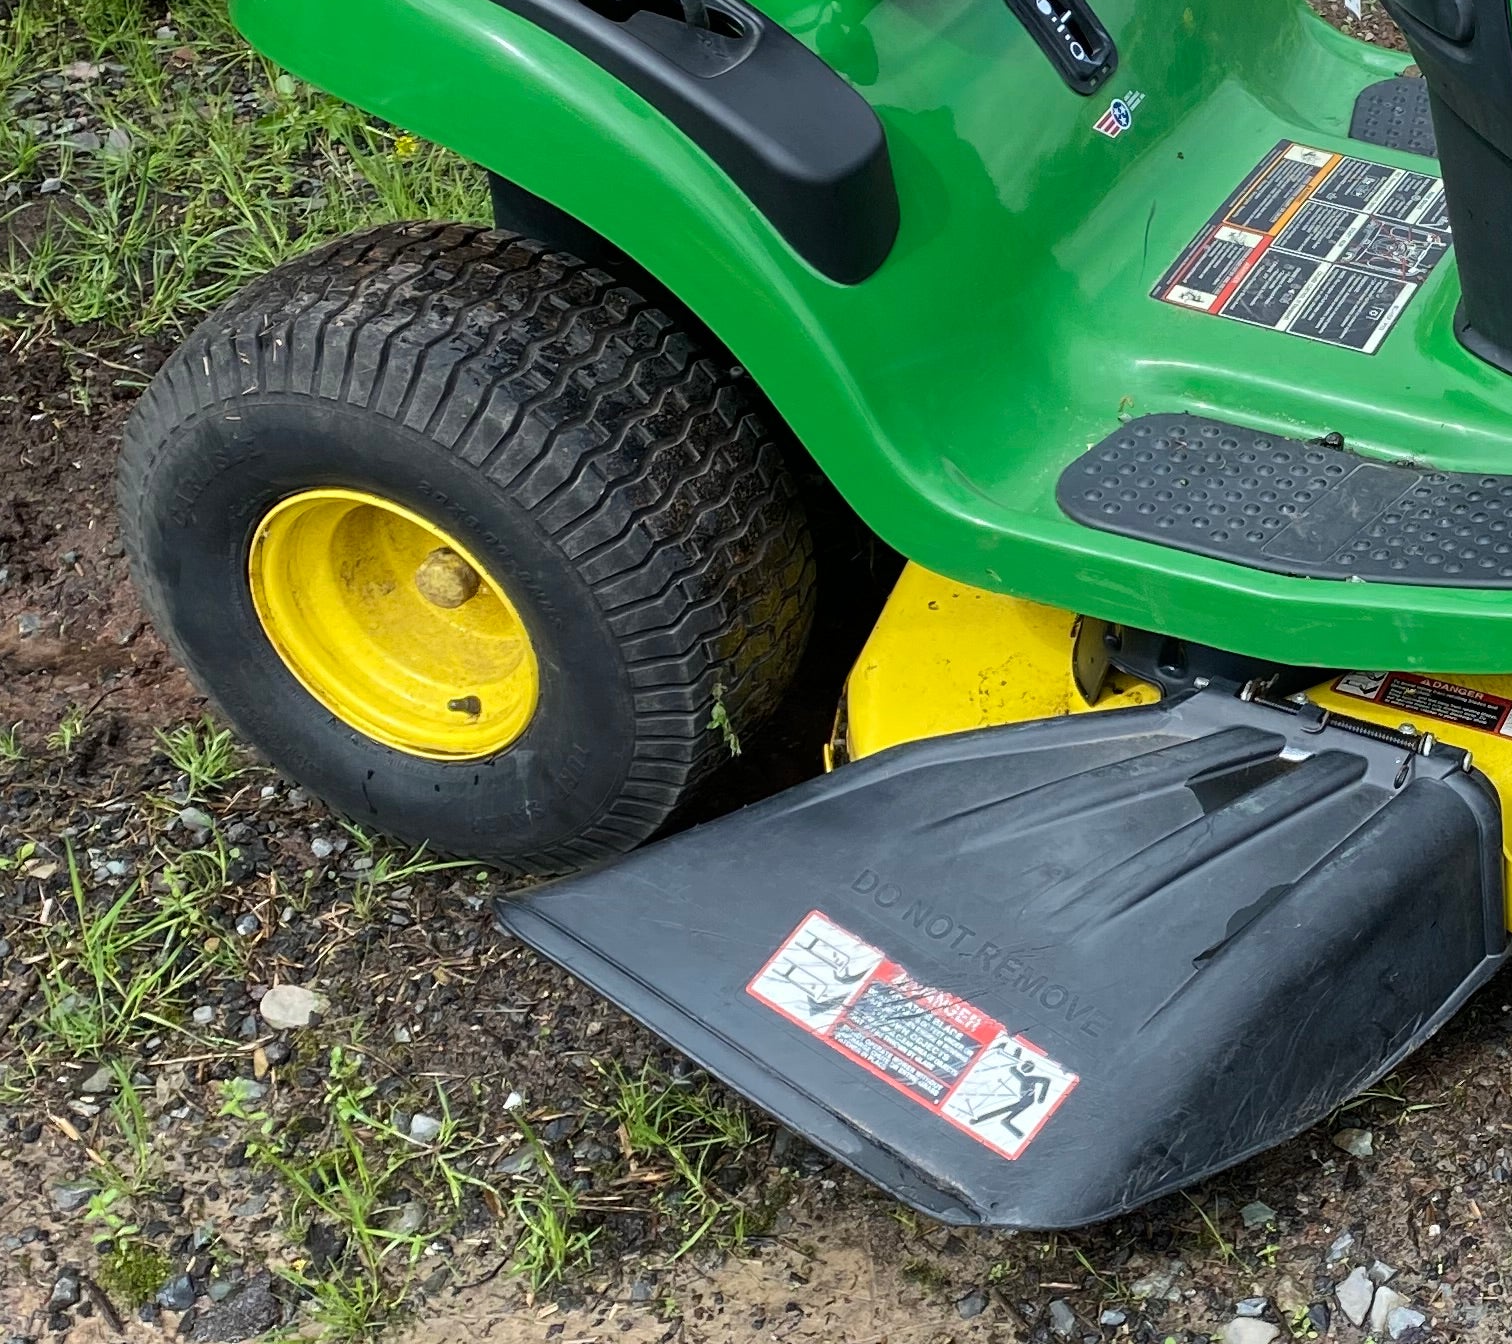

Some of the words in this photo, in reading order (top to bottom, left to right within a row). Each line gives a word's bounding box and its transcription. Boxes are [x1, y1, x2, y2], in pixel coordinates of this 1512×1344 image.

[1432, 680, 1486, 700] DANGER
[850, 868, 903, 908] DO
[901, 899, 977, 950] NOT
[973, 940, 1109, 1039] REMOVE
